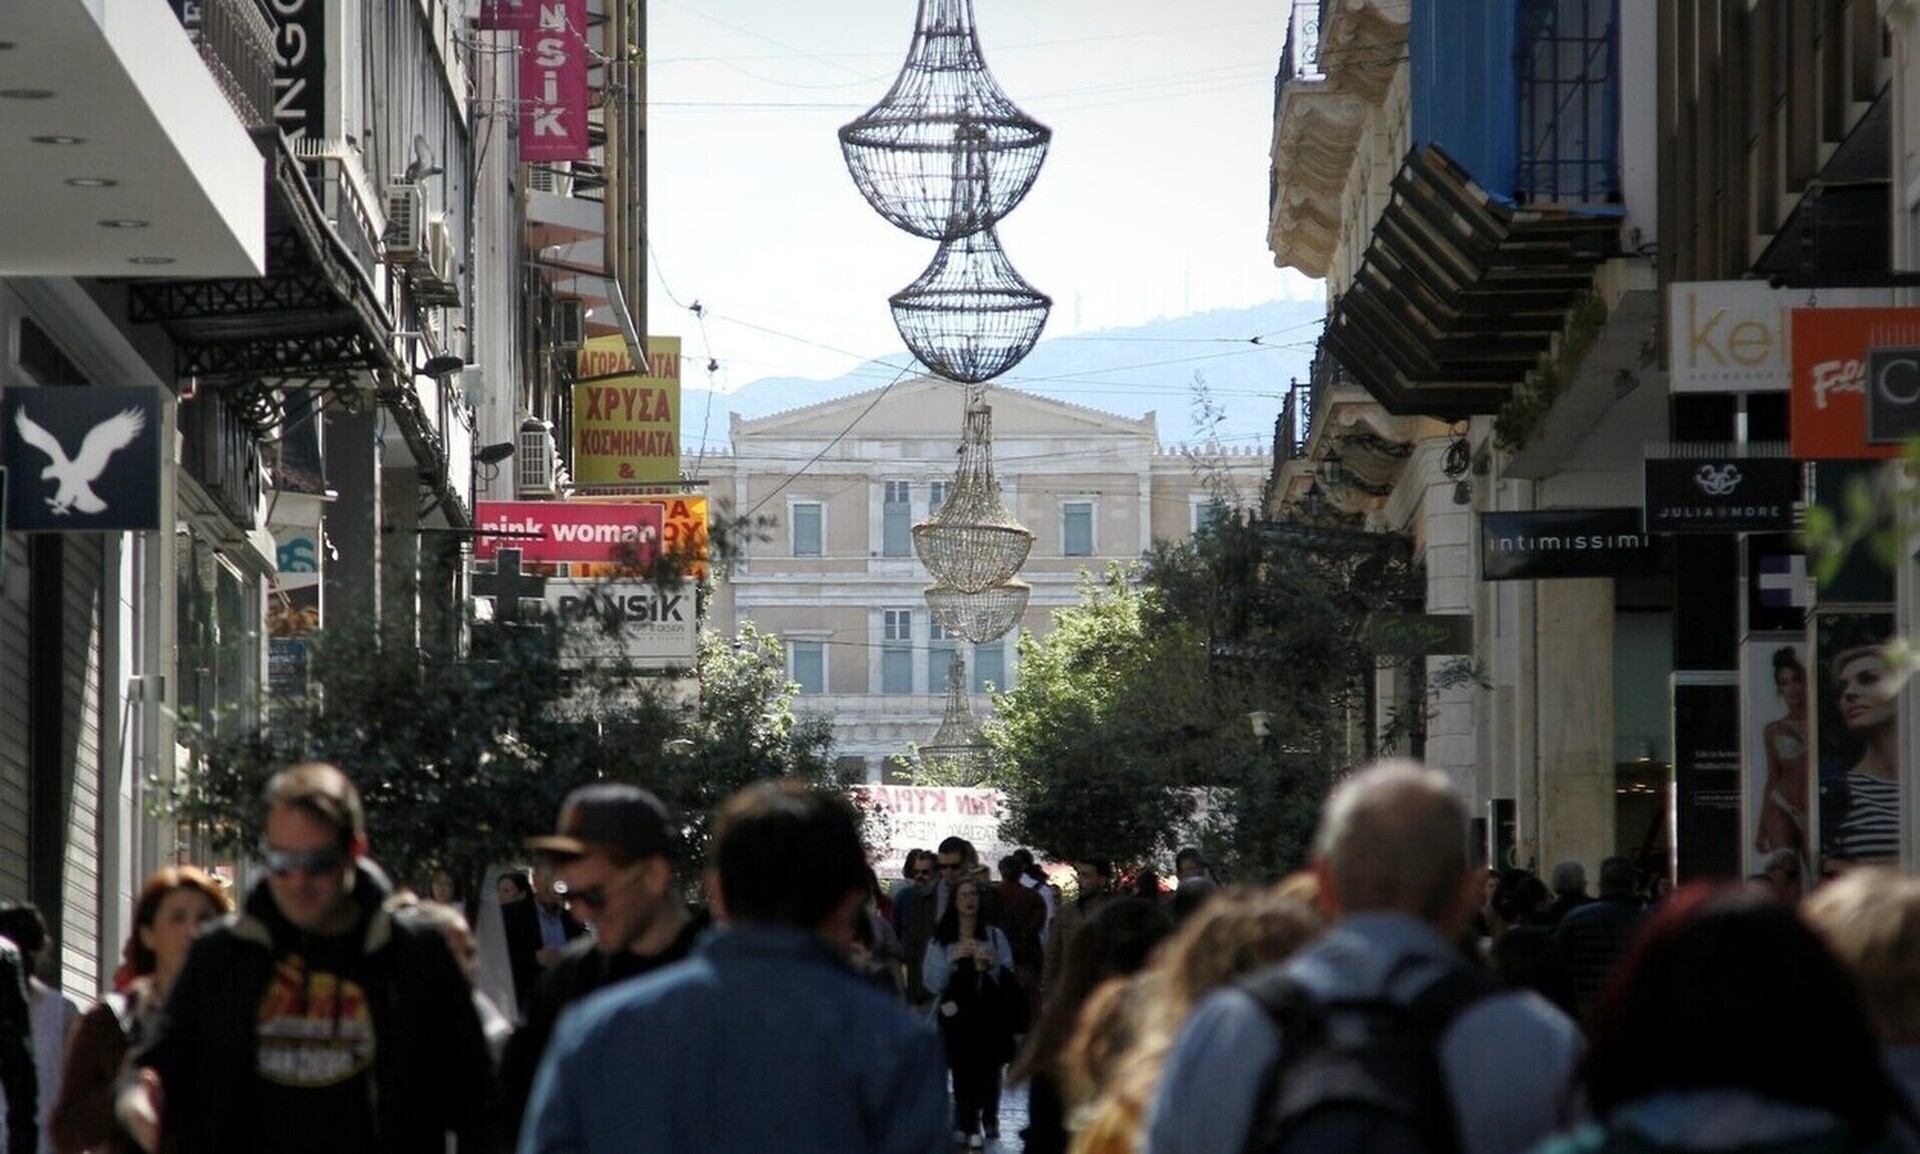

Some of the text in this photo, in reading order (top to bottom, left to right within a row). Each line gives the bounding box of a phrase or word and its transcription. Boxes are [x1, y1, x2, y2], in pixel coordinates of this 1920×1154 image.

[585, 386, 672, 422] ΧΡΥΣΑ
[579, 428, 675, 457] ΚΟΣΜΗΜΑΤΑ
[618, 462, 635, 479] &
[1659, 507, 1714, 518] JULIA
[481, 515, 657, 547] pink woman
[1490, 535, 1650, 552] intimissimi
